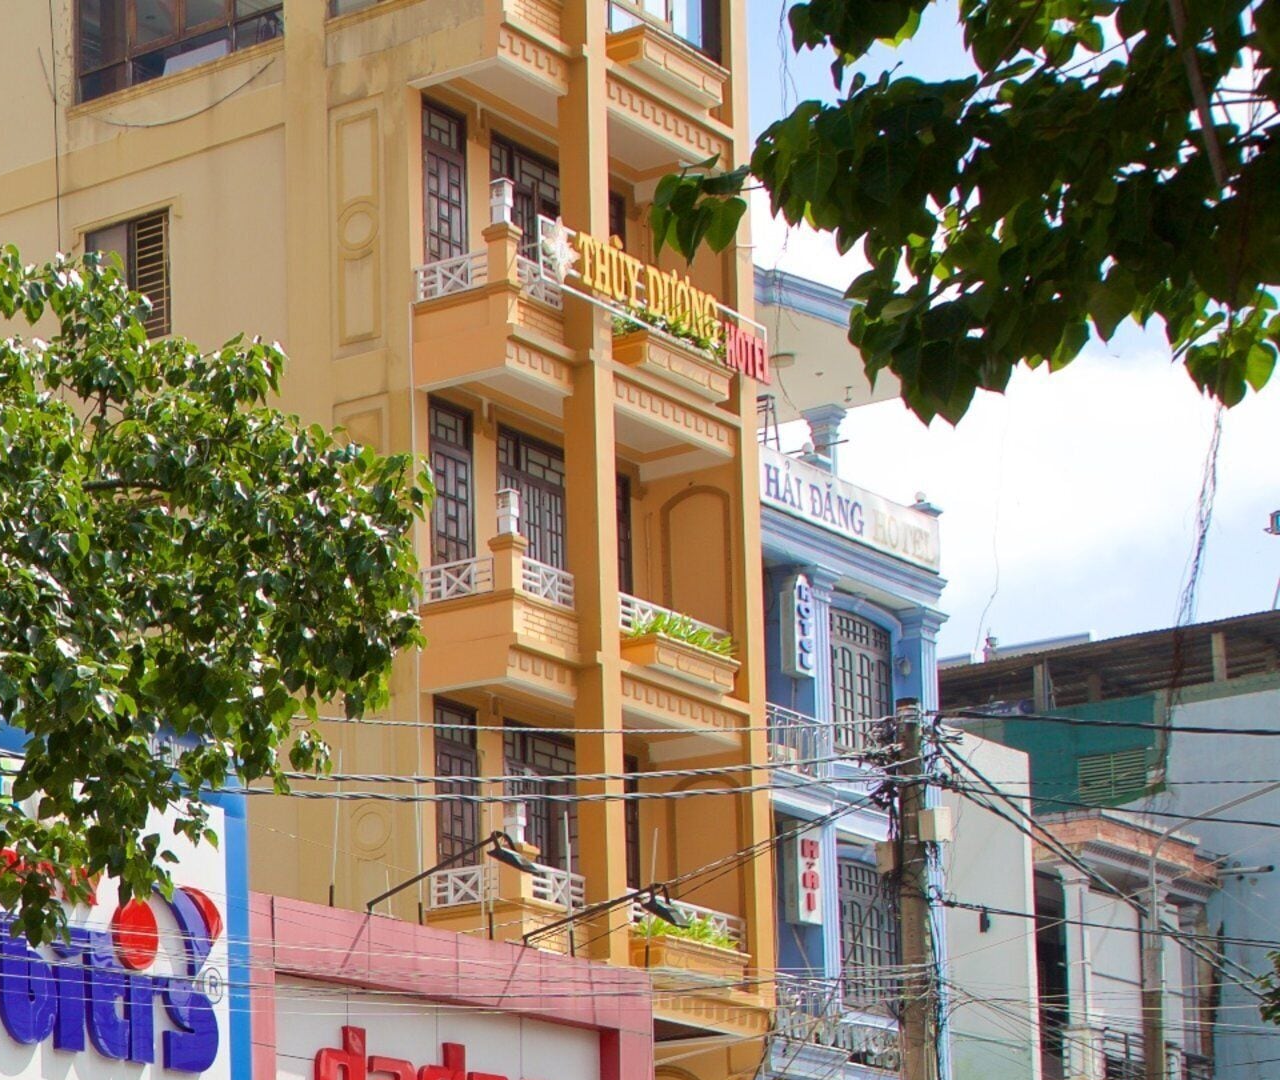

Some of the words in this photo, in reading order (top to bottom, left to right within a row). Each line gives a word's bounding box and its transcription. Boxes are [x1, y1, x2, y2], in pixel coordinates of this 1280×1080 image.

[578, 231, 643, 308] THÙY
[646, 264, 721, 345] DƯƠNG
[764, 459, 804, 512] HẢI
[810, 485, 865, 540] ĐĂNG
[872, 510, 936, 565] HOTEL
[797, 576, 816, 674] HOTEL
